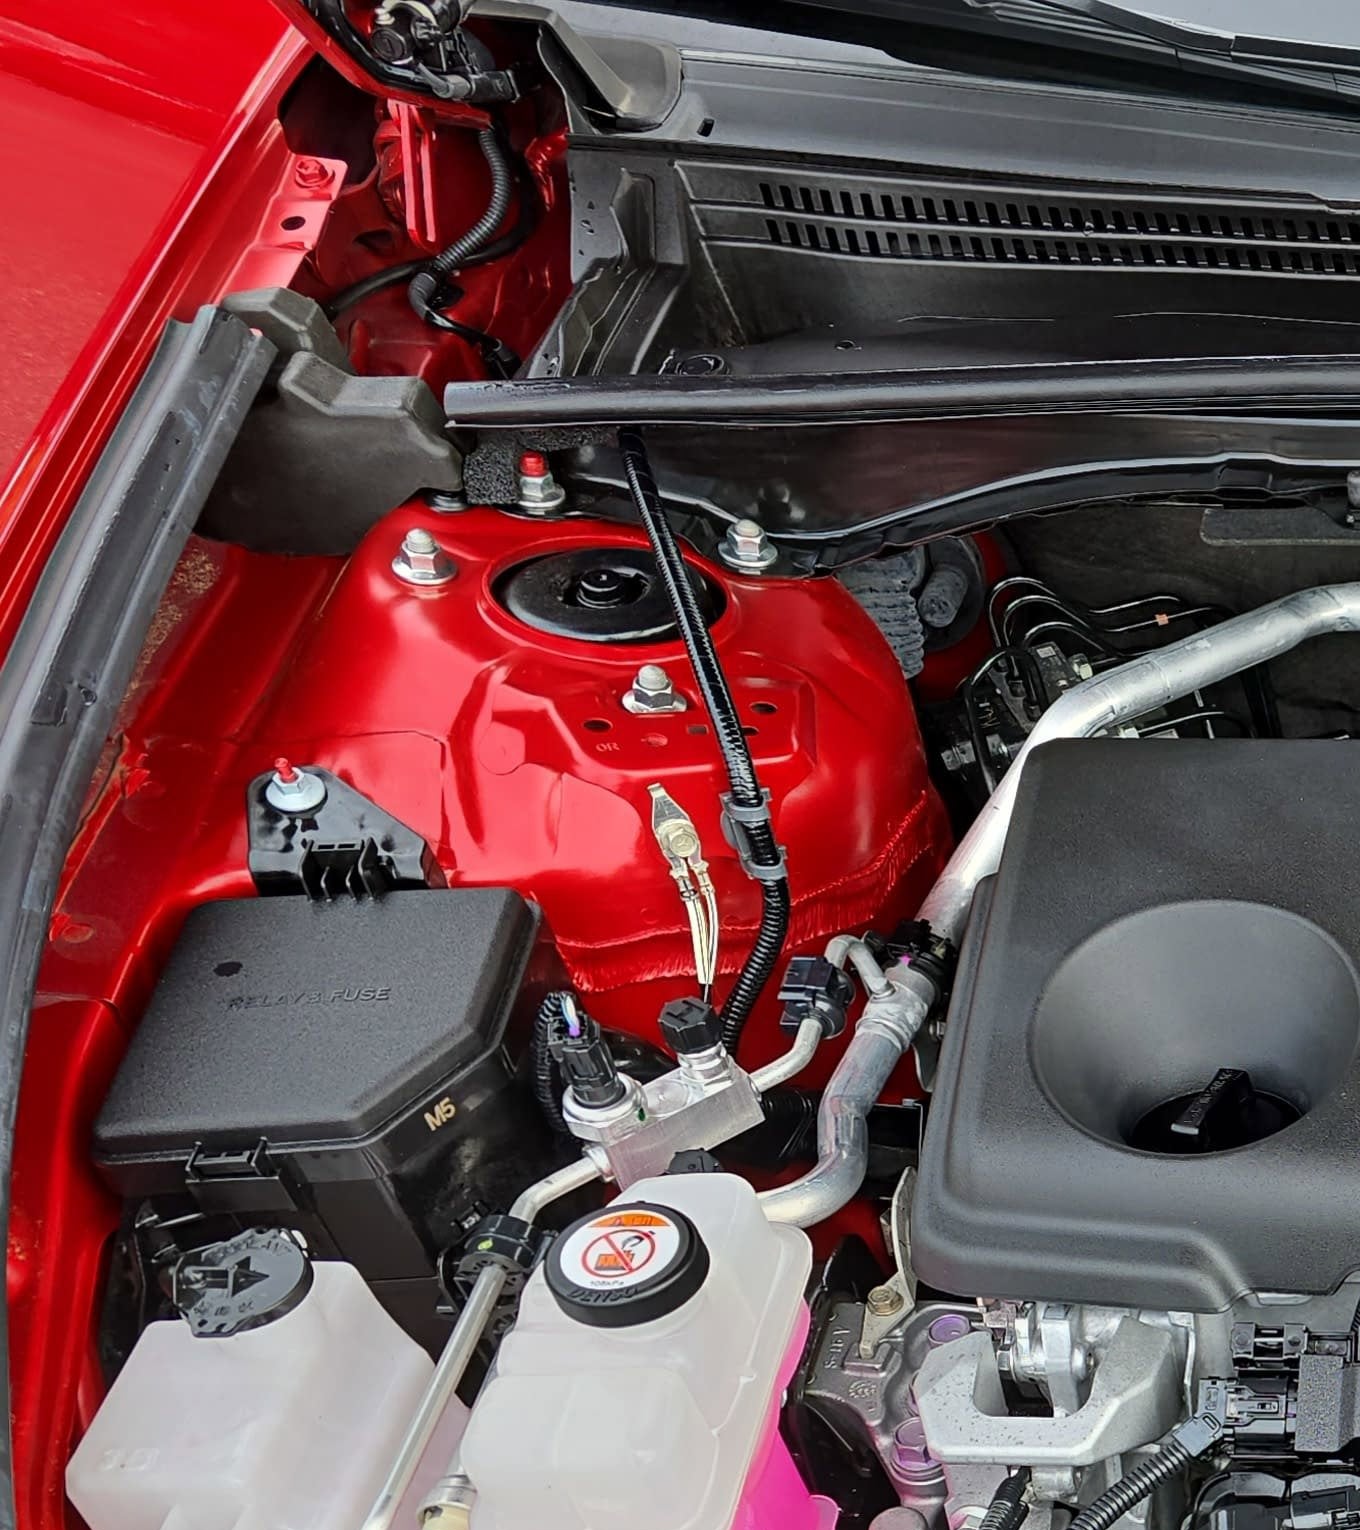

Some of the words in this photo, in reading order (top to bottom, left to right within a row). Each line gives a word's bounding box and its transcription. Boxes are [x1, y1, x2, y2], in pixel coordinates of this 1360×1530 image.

[227, 991, 305, 1011] RELAY
[329, 986, 392, 1003] FUSE
[423, 1096, 456, 1131] M5
[567, 1286, 641, 1304] DENSO
